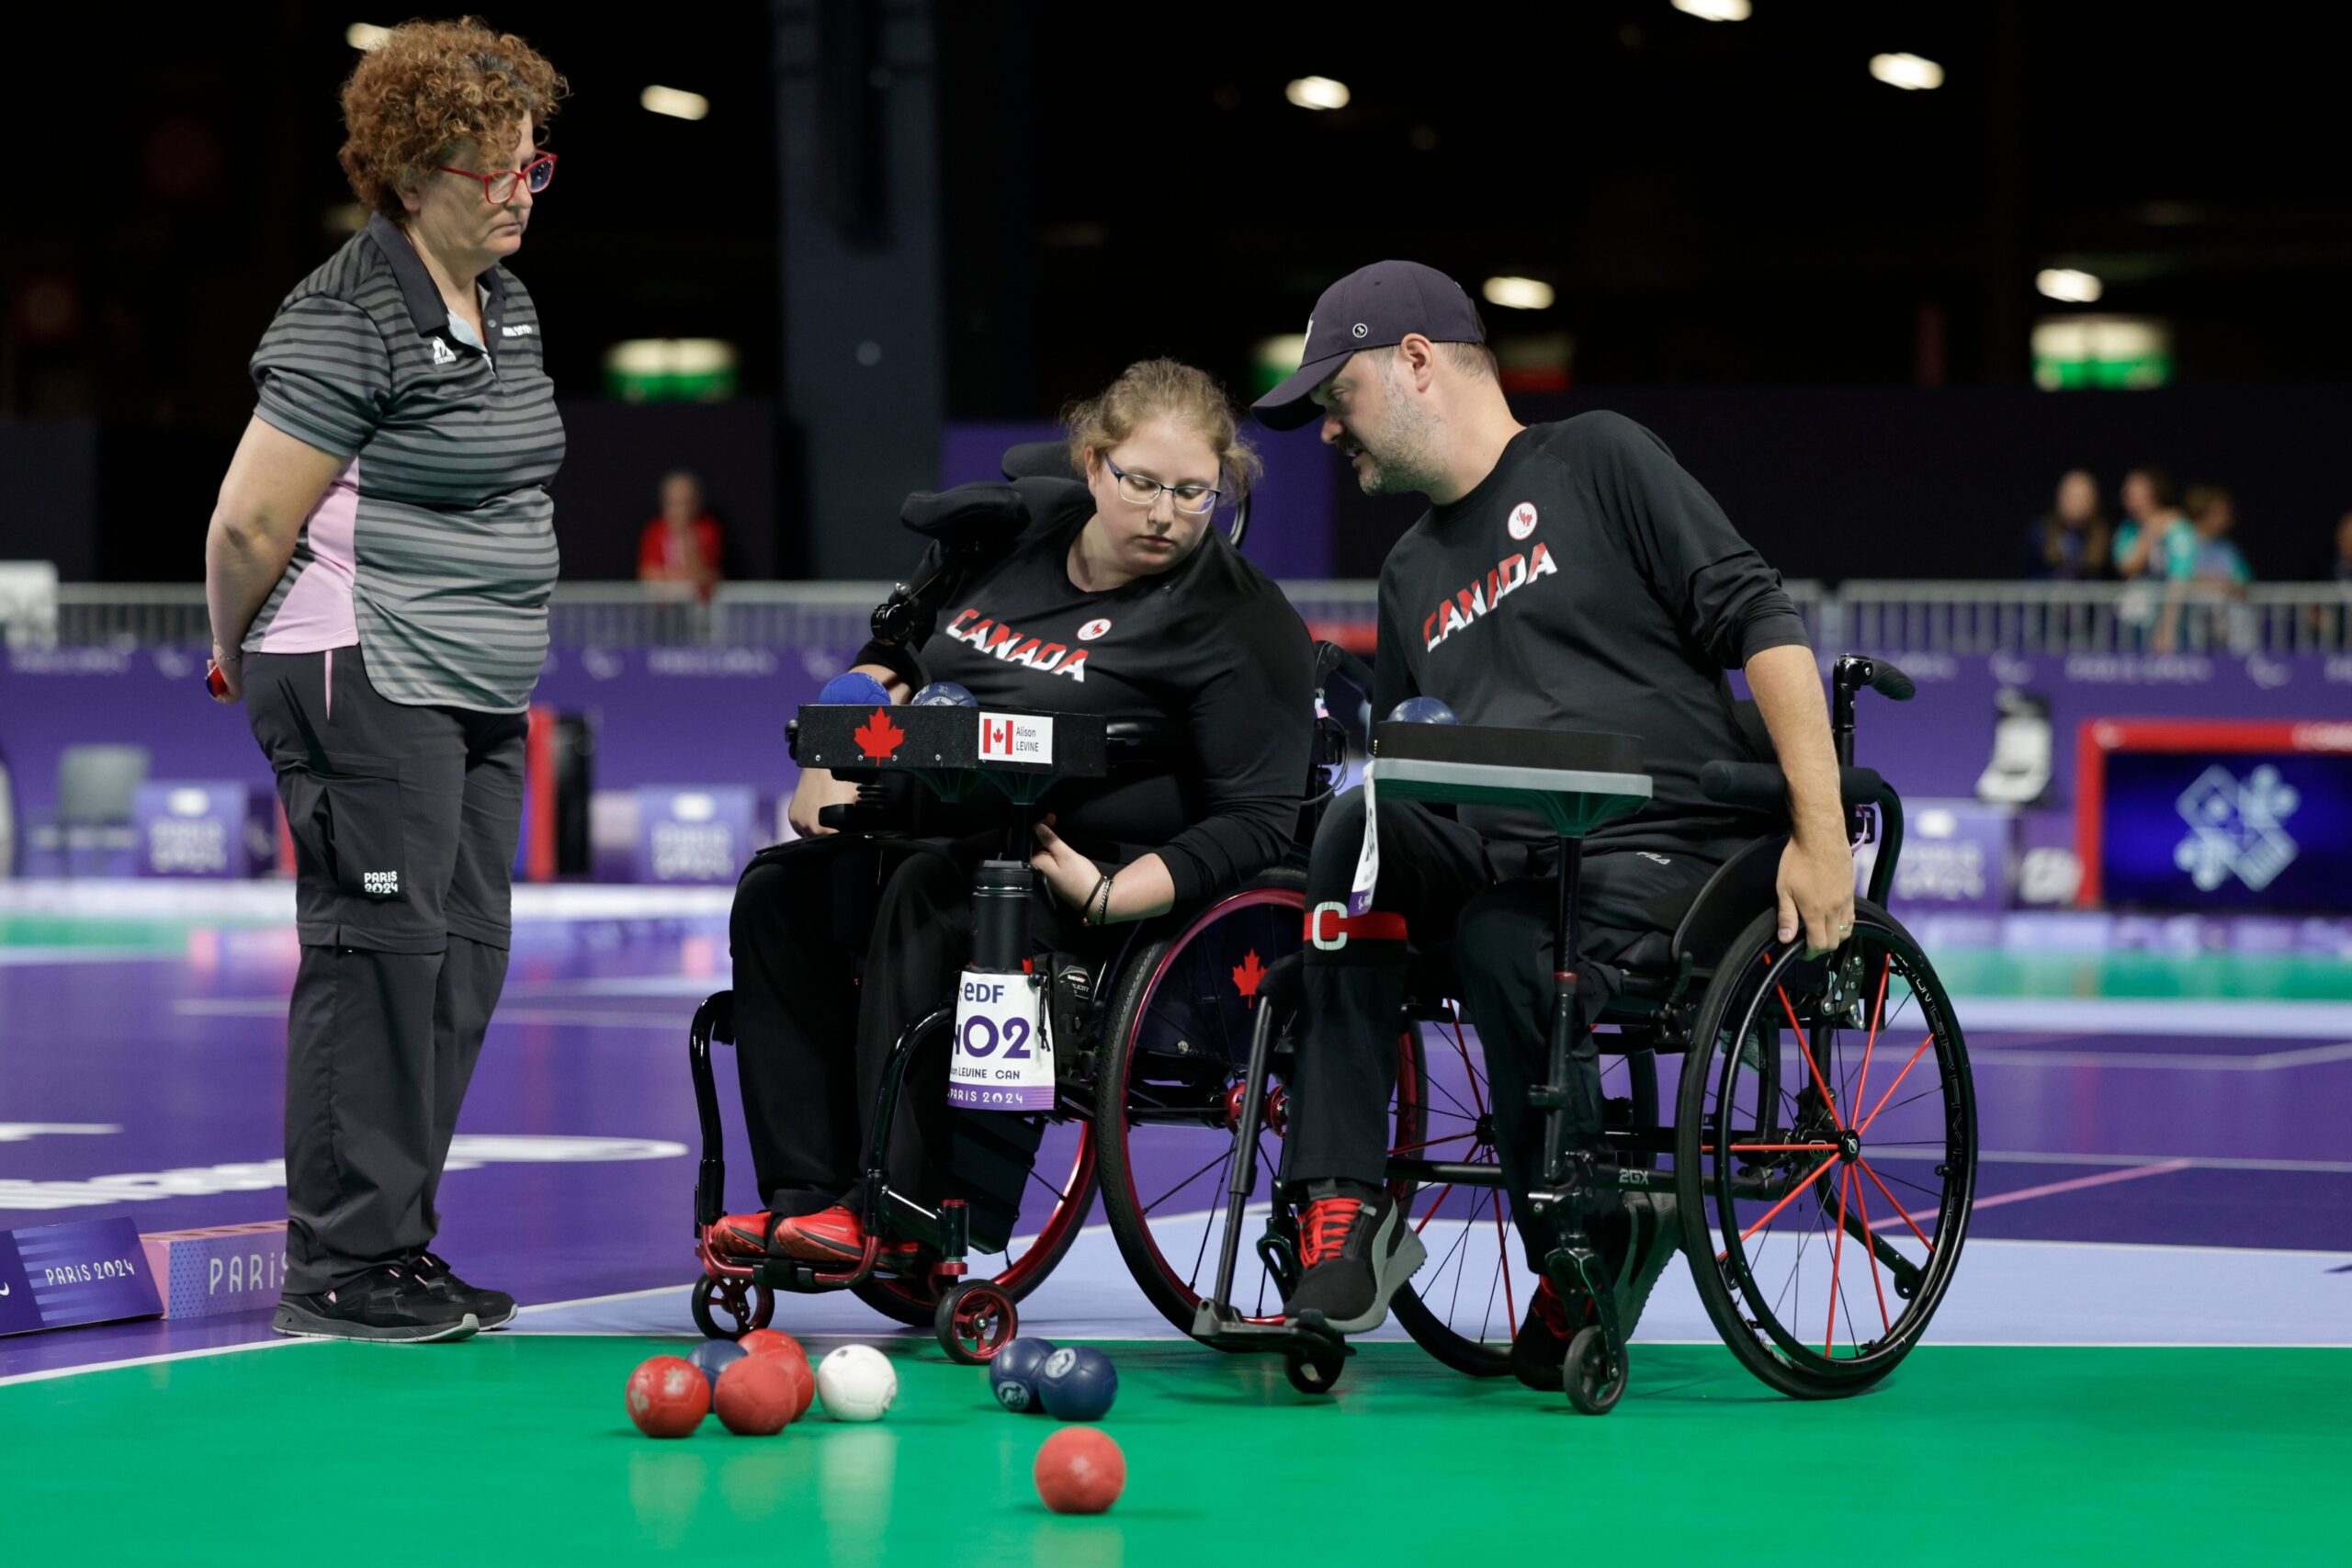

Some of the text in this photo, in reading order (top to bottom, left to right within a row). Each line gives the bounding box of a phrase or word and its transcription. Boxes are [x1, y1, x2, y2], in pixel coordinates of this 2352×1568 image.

[1422, 541, 1558, 653] CANADA
[945, 608, 1089, 682] CANADA
[1015, 727, 1036, 738] Alison
[1015, 740, 1039, 752] LEVINE
[364, 871, 398, 883] PARIS
[364, 882, 399, 894] 2024
[1312, 901, 1348, 951] C
[958, 1066, 988, 1078] LEVINE
[995, 1069, 1021, 1080] CAN
[982, 1091, 1023, 1104] 2024
[93, 1258, 135, 1280] 2024
